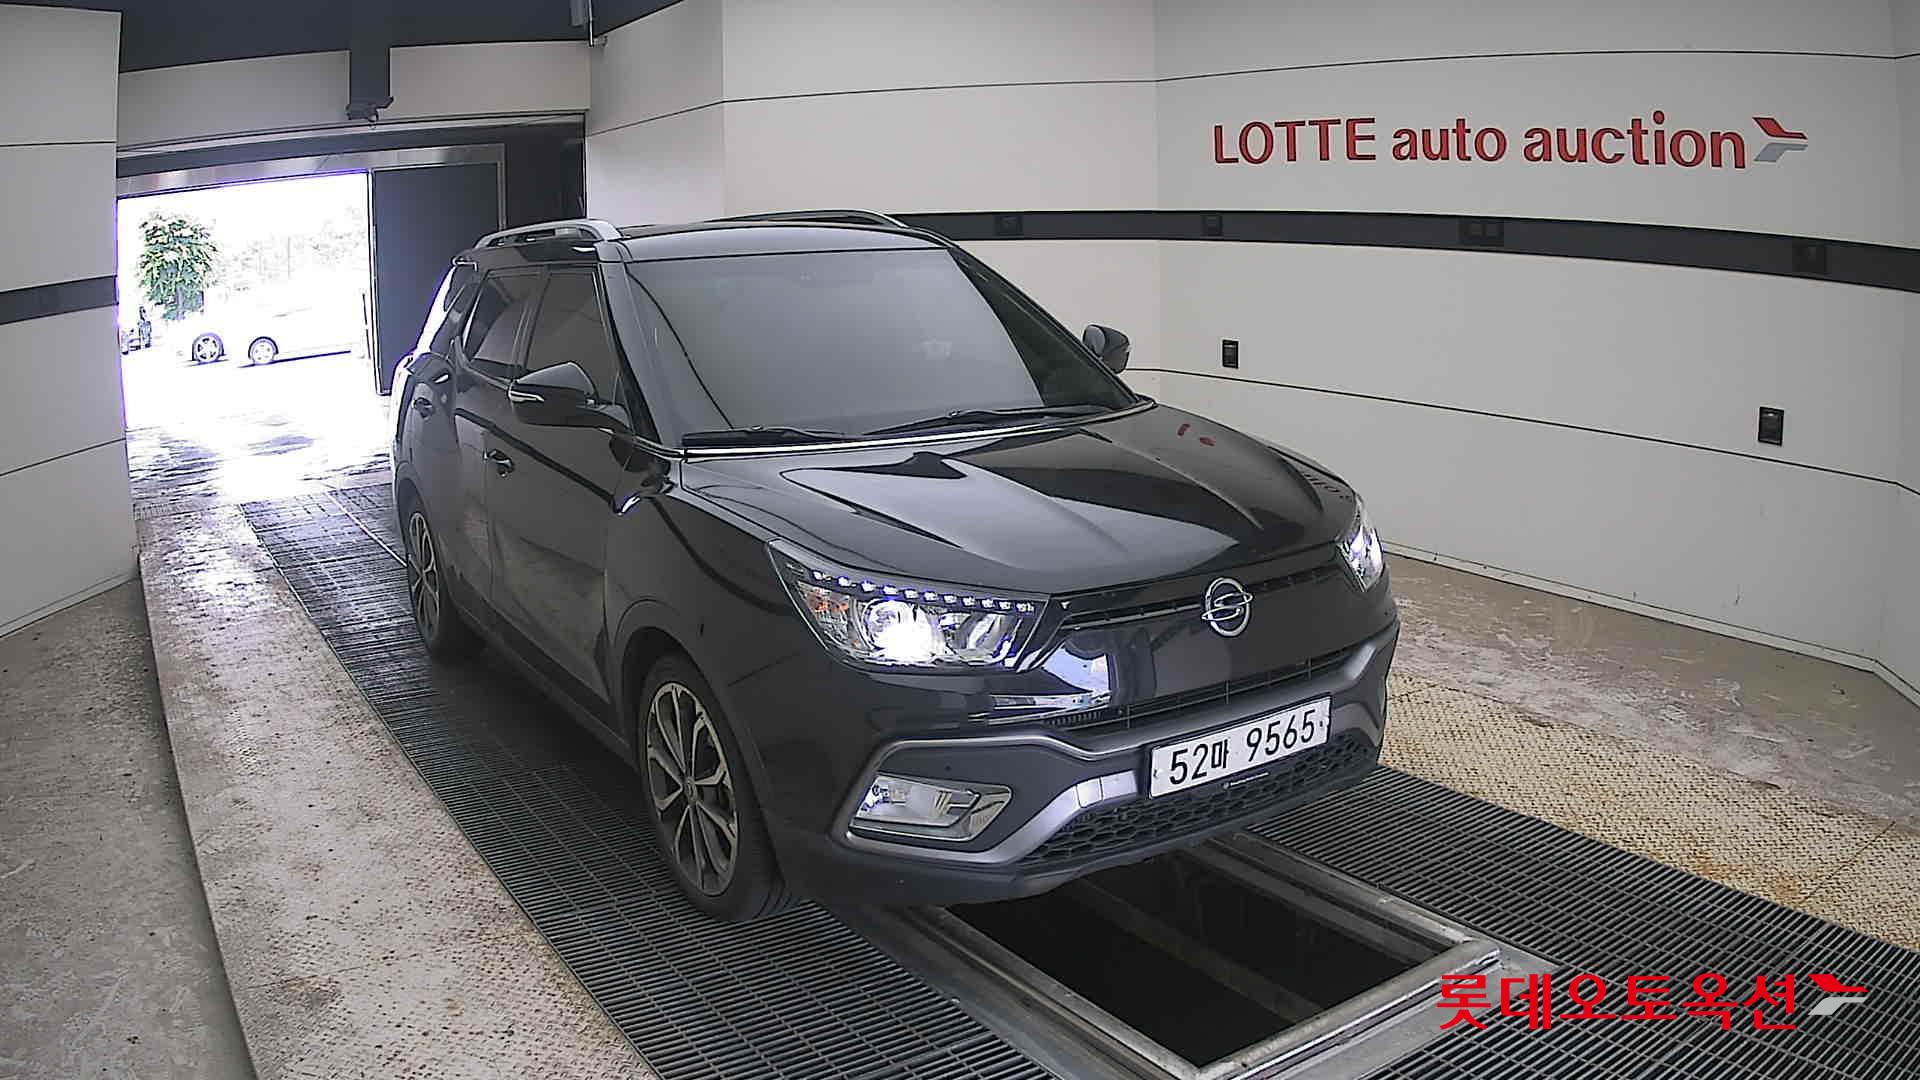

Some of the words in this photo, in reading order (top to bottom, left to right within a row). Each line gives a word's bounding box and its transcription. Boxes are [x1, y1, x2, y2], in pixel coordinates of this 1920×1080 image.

[1213, 117, 1376, 164] LOTTE
[1391, 117, 1506, 162] auto
[1522, 110, 1746, 169] auction
[1169, 738, 1229, 785] 52마
[1246, 709, 1316, 762] 9565
